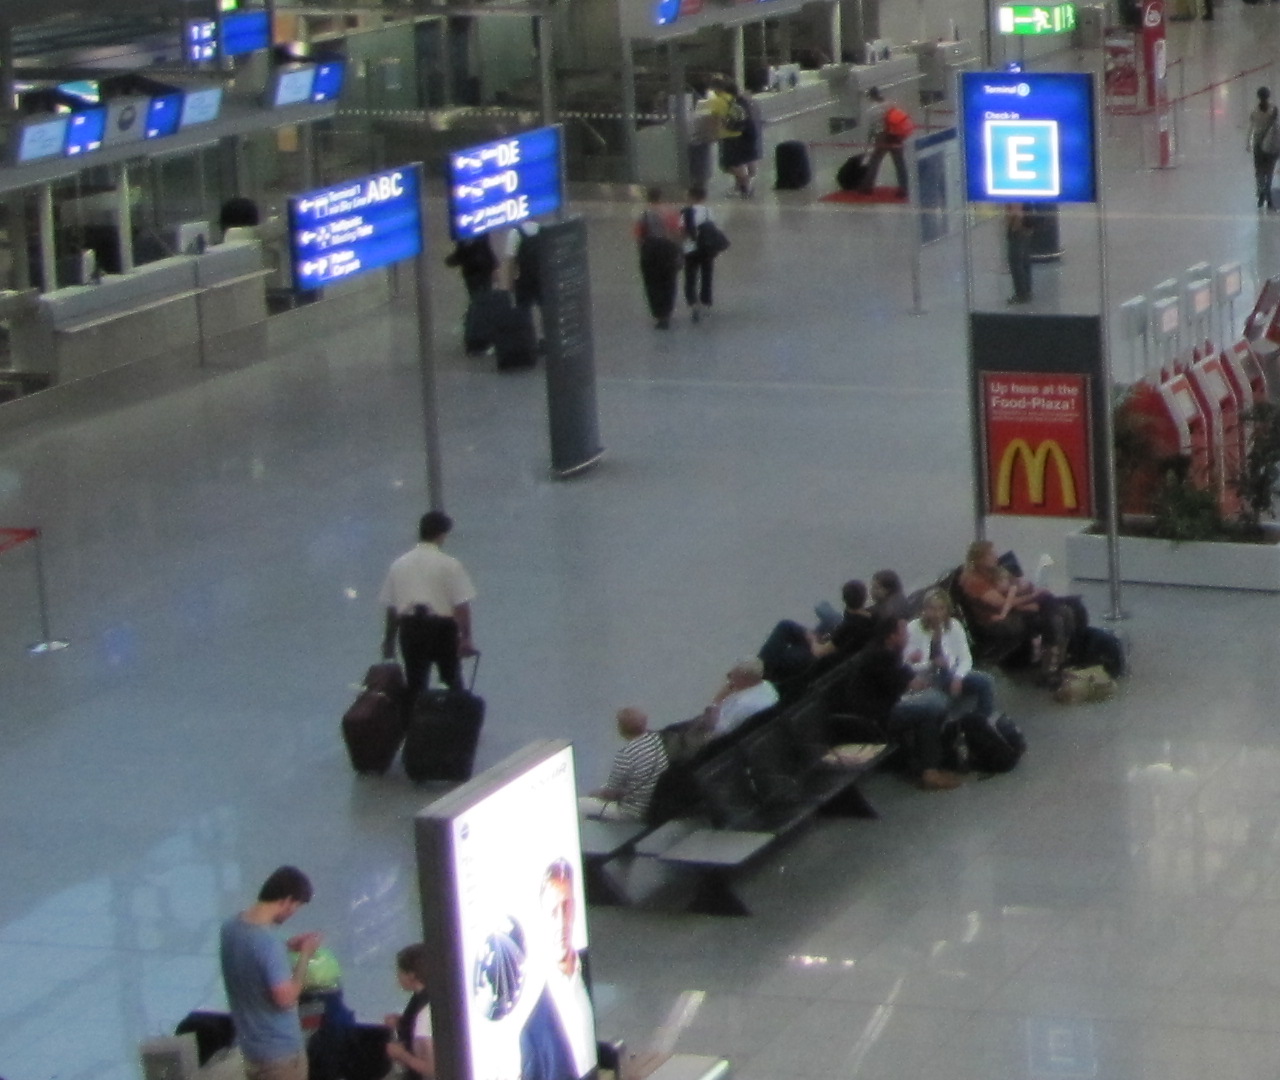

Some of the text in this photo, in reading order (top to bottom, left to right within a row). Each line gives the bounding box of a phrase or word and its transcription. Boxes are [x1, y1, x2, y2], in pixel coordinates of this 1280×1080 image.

[1007, 136, 1037, 180] E
[991, 381, 1008, 396] Up
[1042, 384, 1054, 396] at
[1058, 384, 1079, 397] the
[991, 395, 1075, 411] Food-Plaza!
